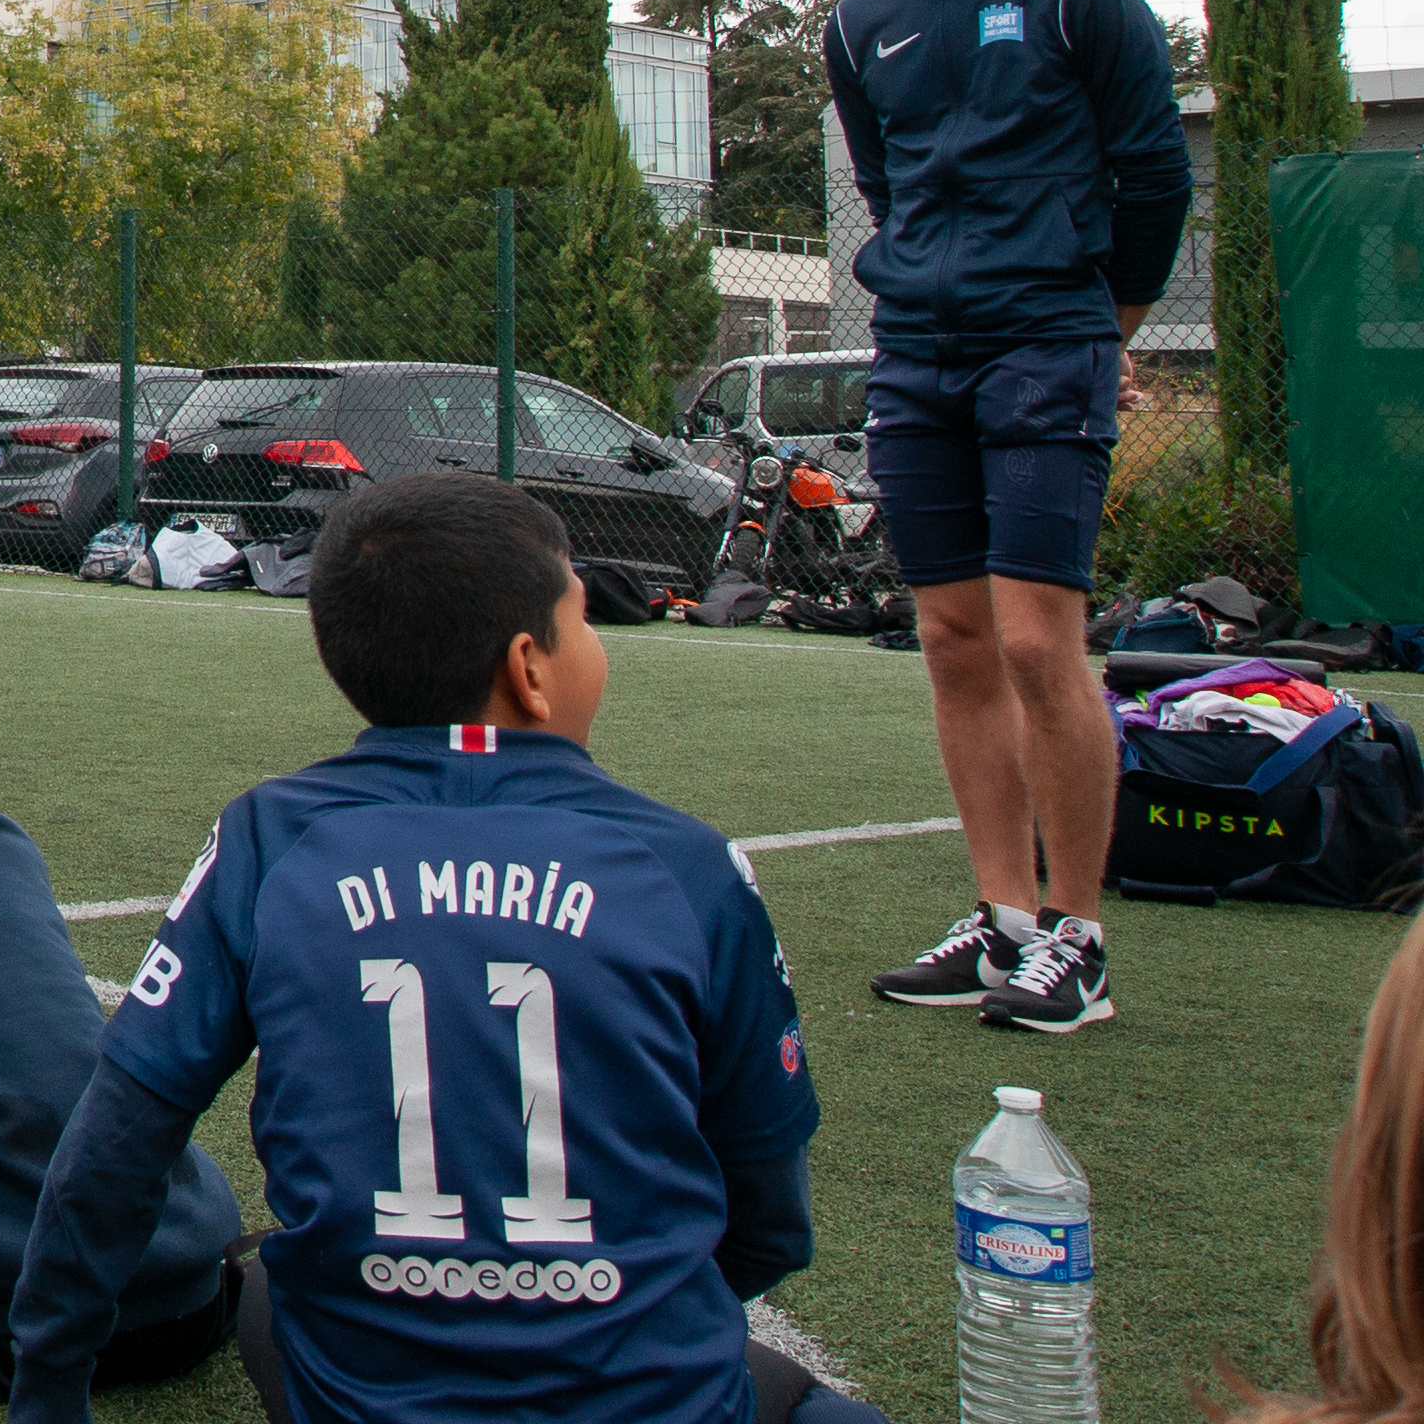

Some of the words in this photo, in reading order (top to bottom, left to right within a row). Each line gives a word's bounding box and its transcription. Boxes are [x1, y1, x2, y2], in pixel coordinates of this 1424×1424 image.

[1149, 804, 1285, 837] KIPSTA
[336, 866, 396, 932] DI
[359, 958, 593, 1243] 11
[977, 1233, 1064, 1259] CRISTALINE
[365, 1258, 616, 1298] ooredoo
